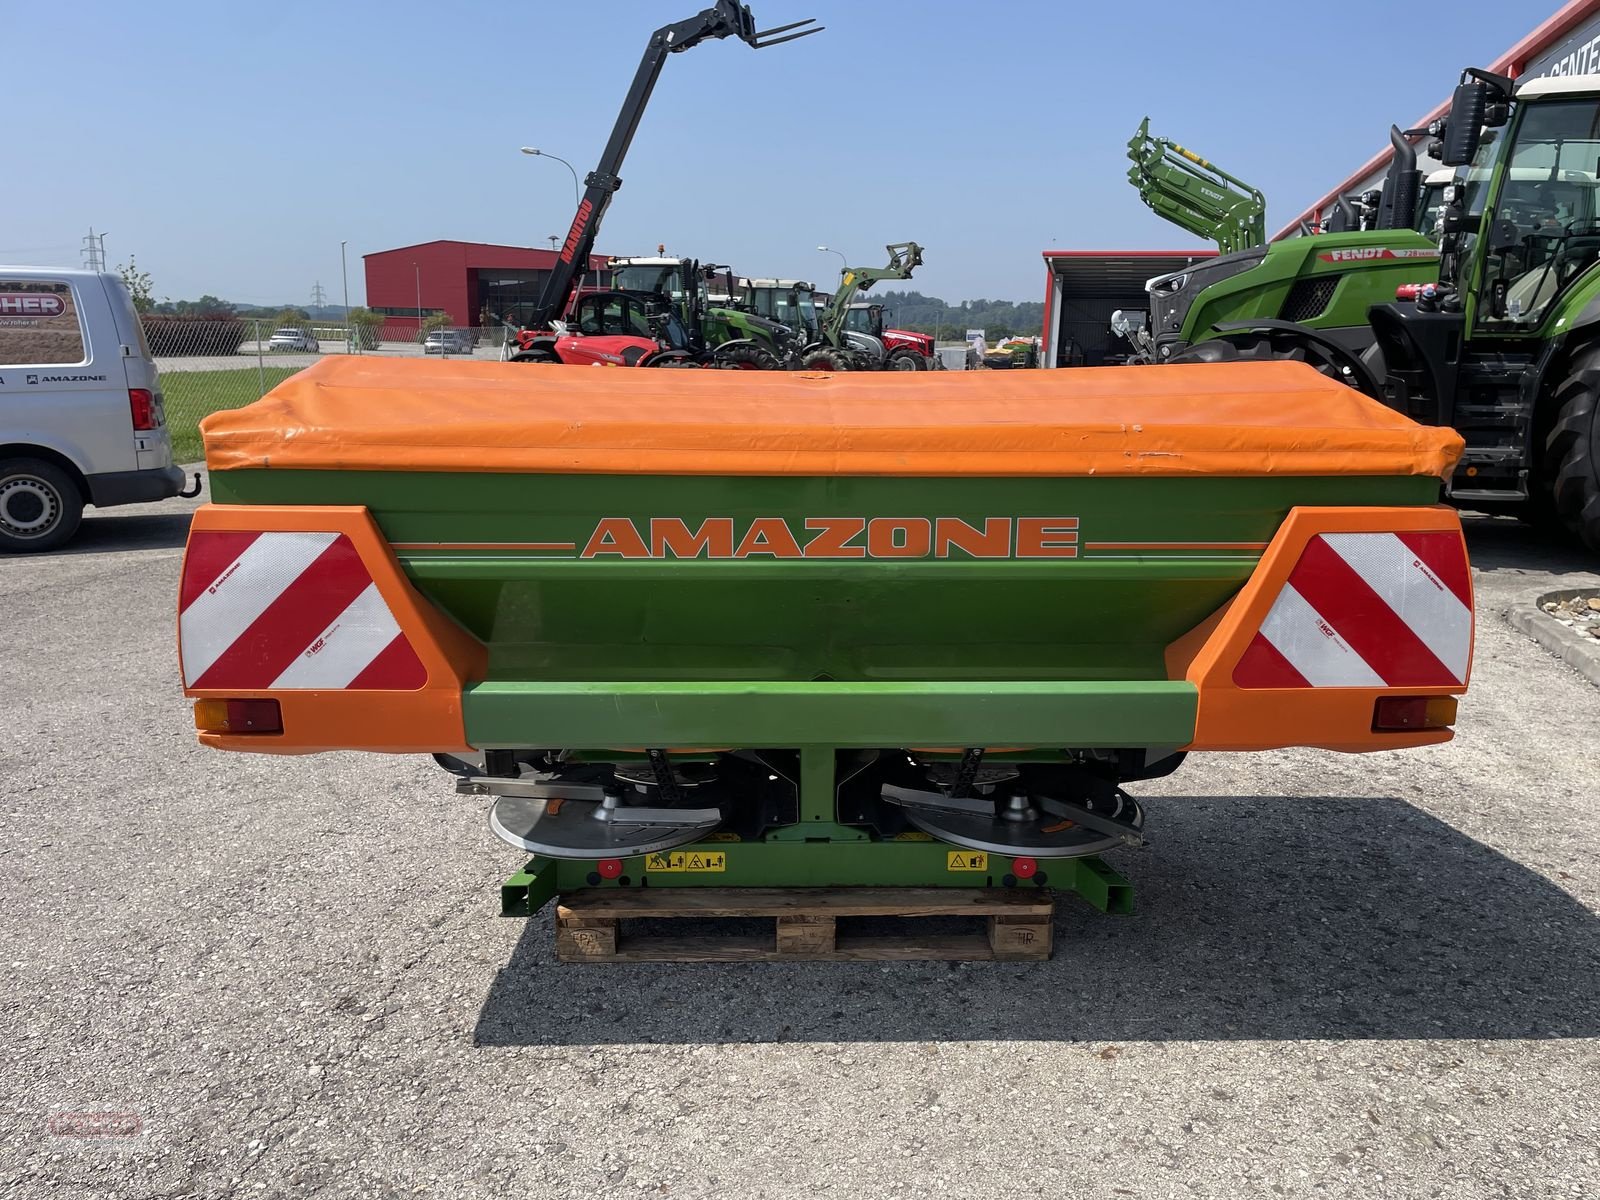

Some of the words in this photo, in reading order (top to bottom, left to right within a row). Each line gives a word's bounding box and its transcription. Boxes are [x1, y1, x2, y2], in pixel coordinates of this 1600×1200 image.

[1200, 187, 1225, 201] FENDT
[560, 198, 593, 265] MANITOU
[1331, 247, 1387, 261] FENDT
[580, 517, 1080, 559] AMAZONE
